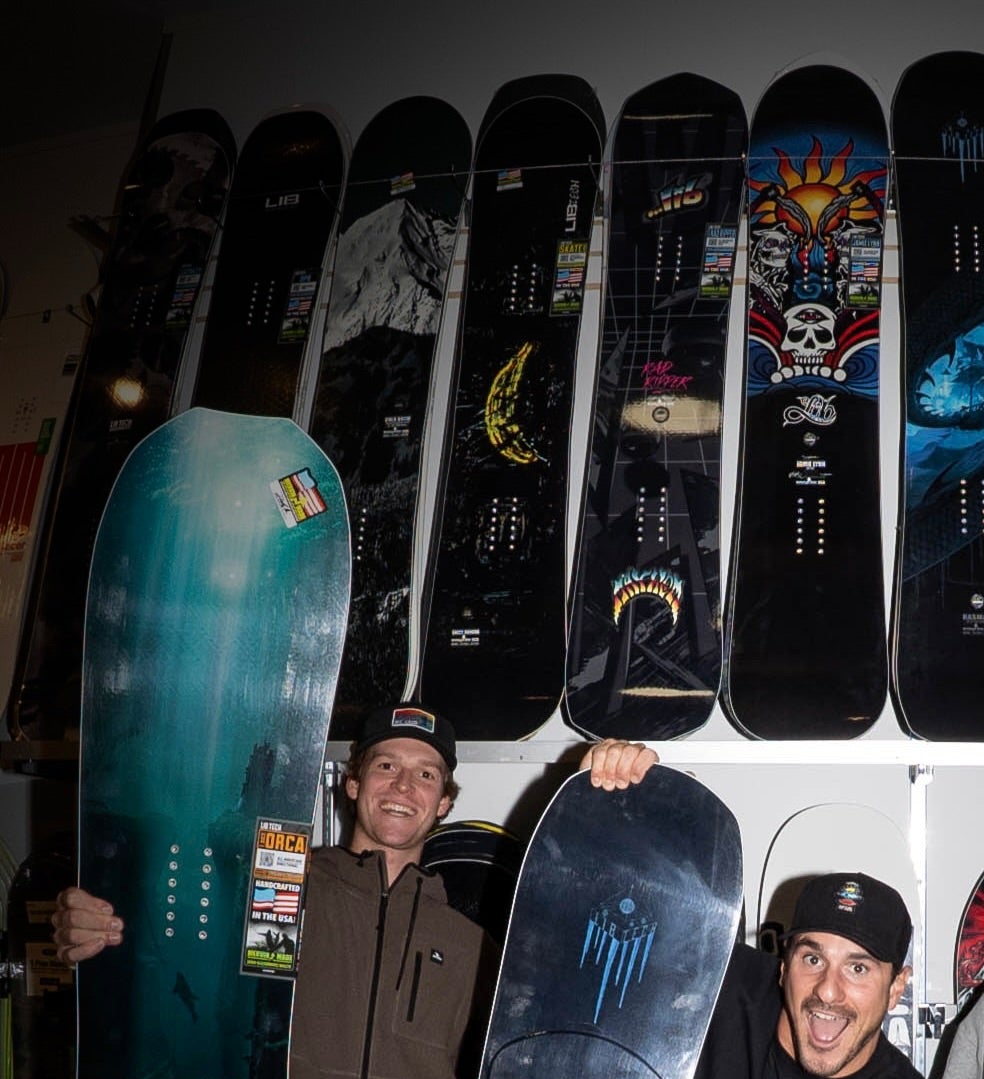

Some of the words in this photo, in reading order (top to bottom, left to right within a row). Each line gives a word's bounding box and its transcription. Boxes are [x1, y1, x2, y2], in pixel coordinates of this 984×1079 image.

[264, 193, 301, 209] LIB
[265, 833, 304, 854] ORCA
[255, 880, 300, 892] HANDCRAFTED
[252, 911, 261, 920] IN
[262, 912, 277, 922] THE
[278, 915, 296, 924] USA!
